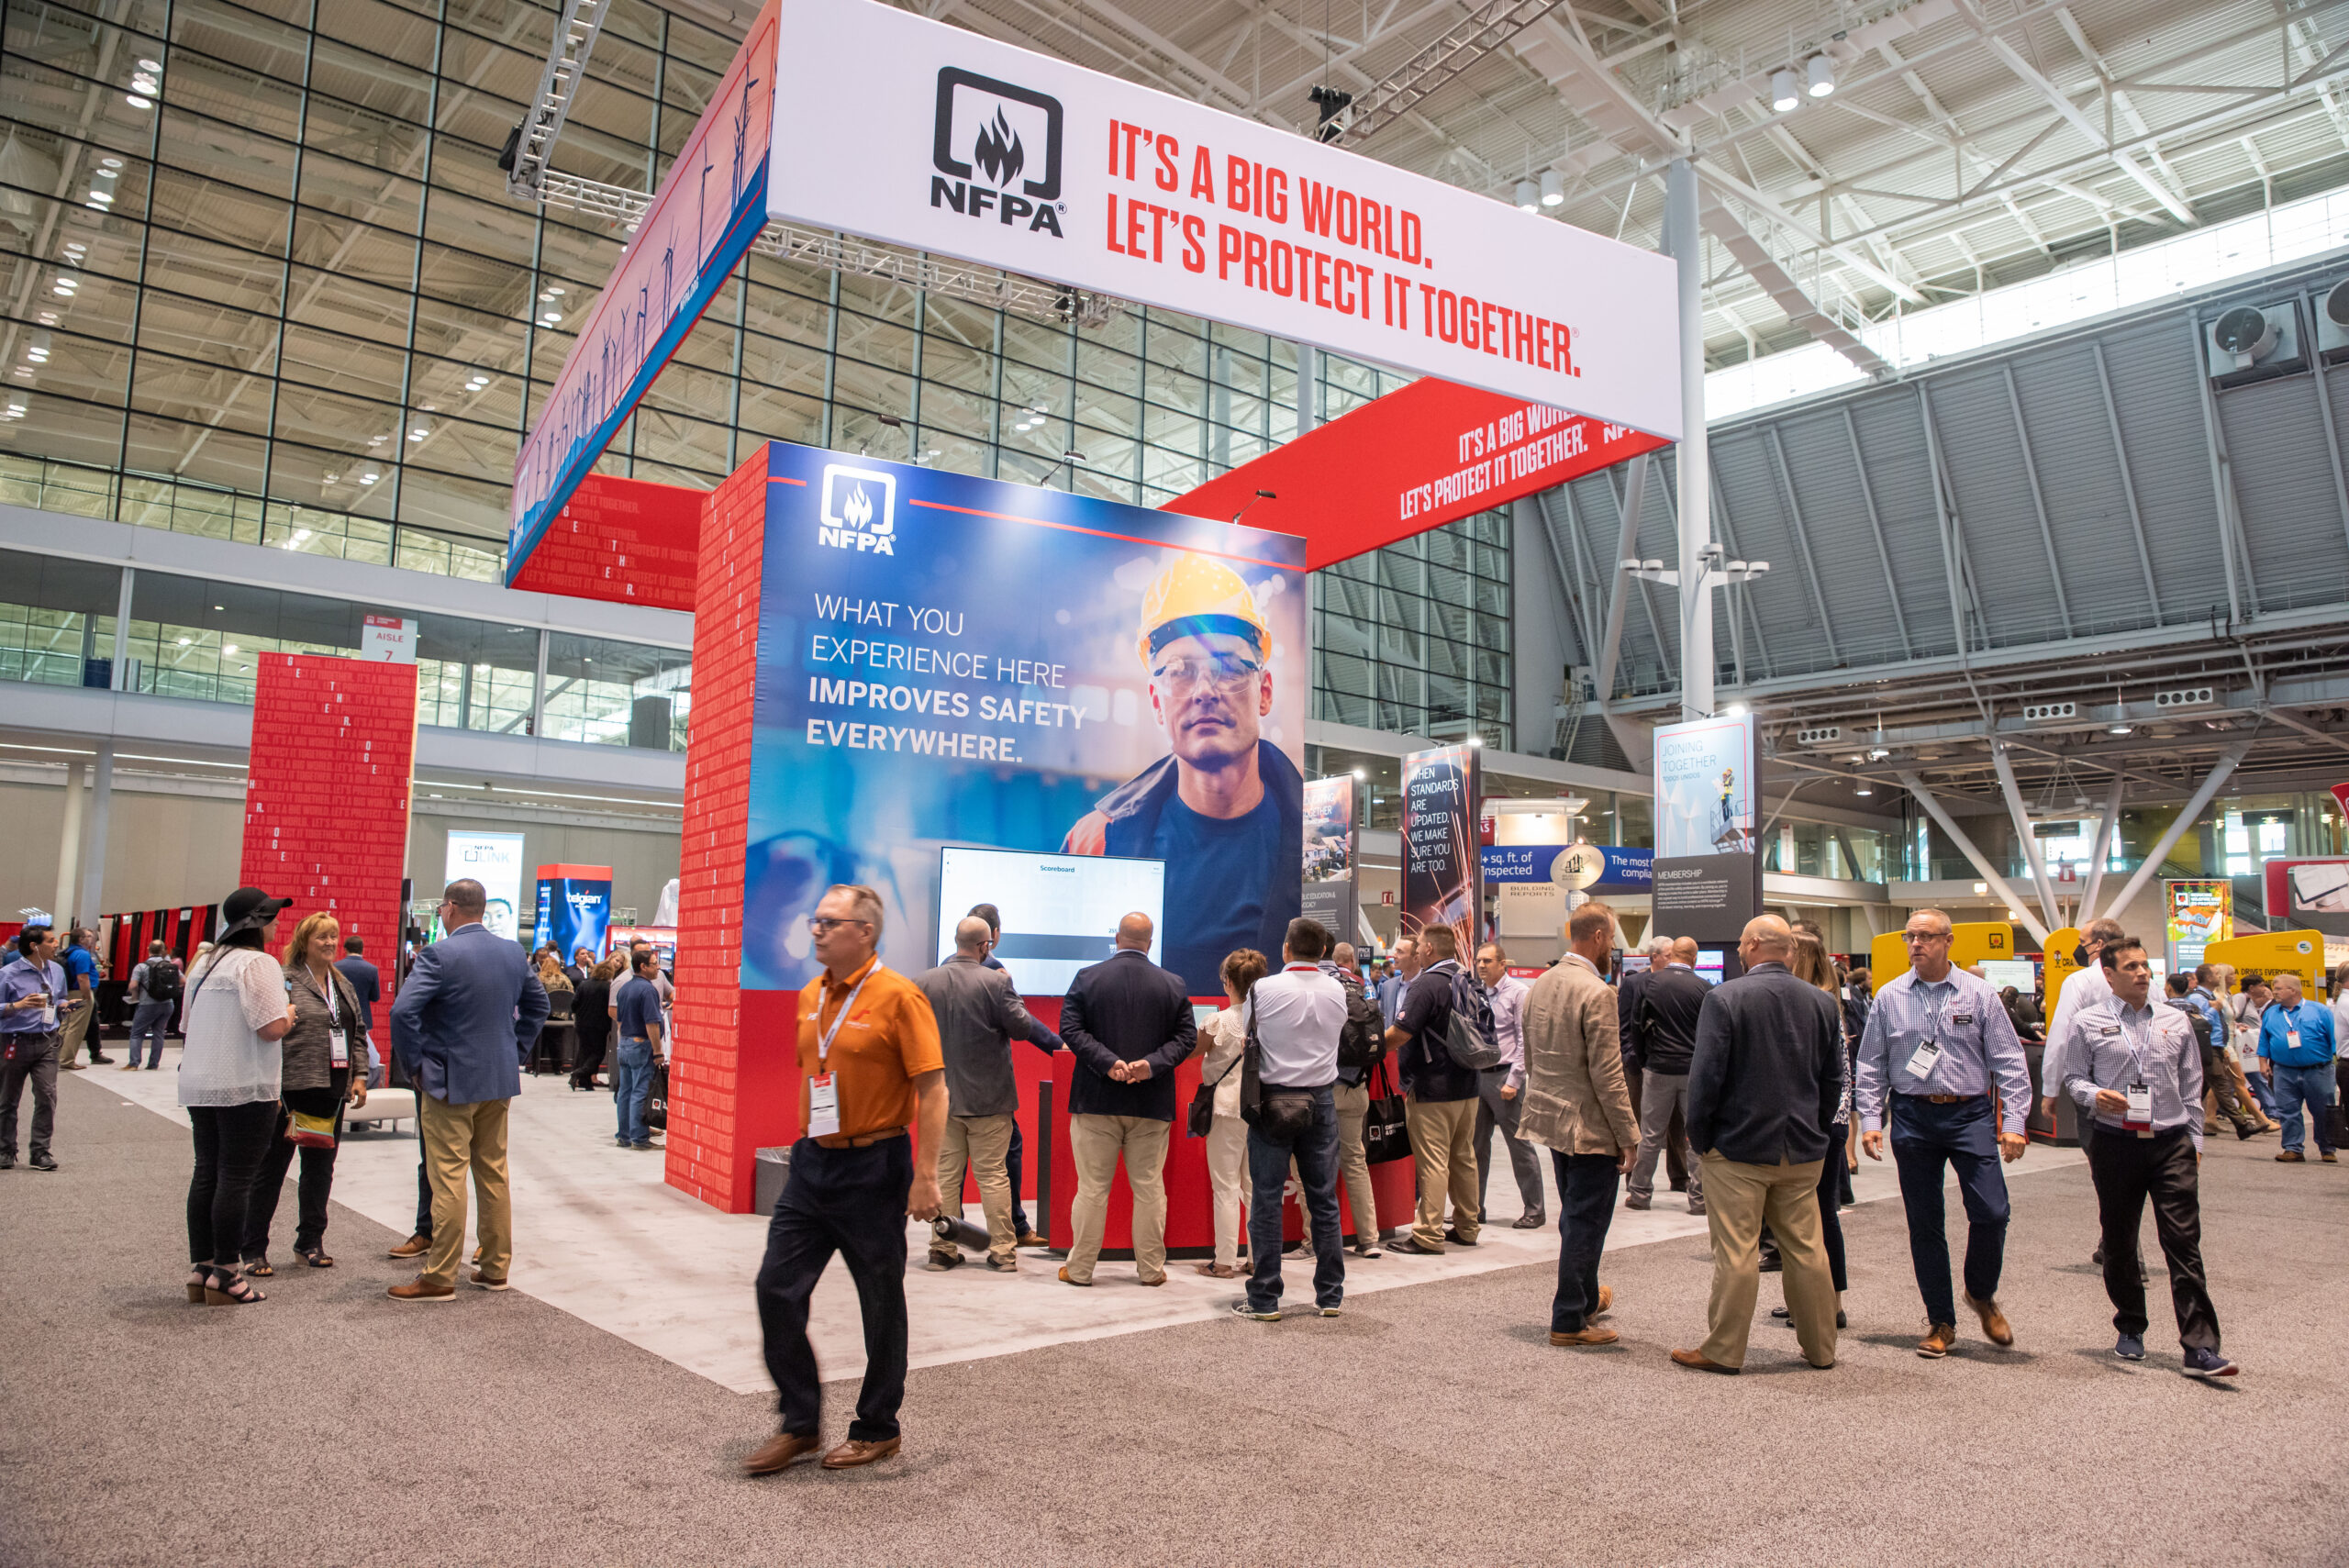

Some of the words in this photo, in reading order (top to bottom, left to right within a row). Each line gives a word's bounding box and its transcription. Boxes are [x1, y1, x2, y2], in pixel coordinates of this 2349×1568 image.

[1108, 118, 1179, 193] IT'S
[1190, 144, 1215, 204] A
[1228, 153, 1288, 224] BIG
[1299, 176, 1432, 270] WORLD.
[1107, 193, 1205, 273] LET'S
[1219, 223, 1374, 320] PROTECT
[1385, 272, 1411, 330] IT
[1459, 427, 1484, 463] IT'S
[1486, 422, 1497, 452] A
[1499, 409, 1523, 448] BIG
[1400, 483, 1431, 520] LET'S
[1434, 461, 1492, 508] PROTECT
[1495, 455, 1507, 486] IT
[814, 593, 899, 628] WHAT
[907, 605, 963, 636] YOU
[375, 632, 404, 643] AISLE
[384, 650, 394, 662] 7
[811, 634, 988, 680] EXPERIENCE
[997, 657, 1066, 689] HERE
[809, 676, 970, 717] IMPROVES
[979, 695, 1087, 729] SAFETY
[807, 718, 1023, 763] EVERYWHERE.
[1662, 740, 1704, 757] JOINING
[1662, 754, 1718, 773] TOGETHER
[1411, 766, 1435, 781] WHEN
[1410, 778, 1459, 796] STANDARDS
[1410, 798, 1427, 812] ARE
[1410, 812, 1450, 828] UPDATED.
[1410, 829, 1423, 842] WE
[1424, 827, 1448, 841] MAKE
[479, 851, 509, 863] LINK
[1410, 844, 1431, 859] SURE
[1433, 842, 1451, 856] YOU
[1490, 854, 1505, 865] sq.
[1507, 851, 1519, 862] ft.
[1520, 851, 1533, 862] of
[1410, 861, 1427, 873] ARE
[1428, 859, 1447, 873] TOO.
[1610, 854, 1628, 866] The
[1629, 858, 1650, 867] most
[1040, 864, 1075, 873] Scoreboard
[1481, 864, 1532, 877] nspected
[1657, 869, 1703, 880] MEMBERSHIP
[2241, 968, 2263, 976] DRIVES
